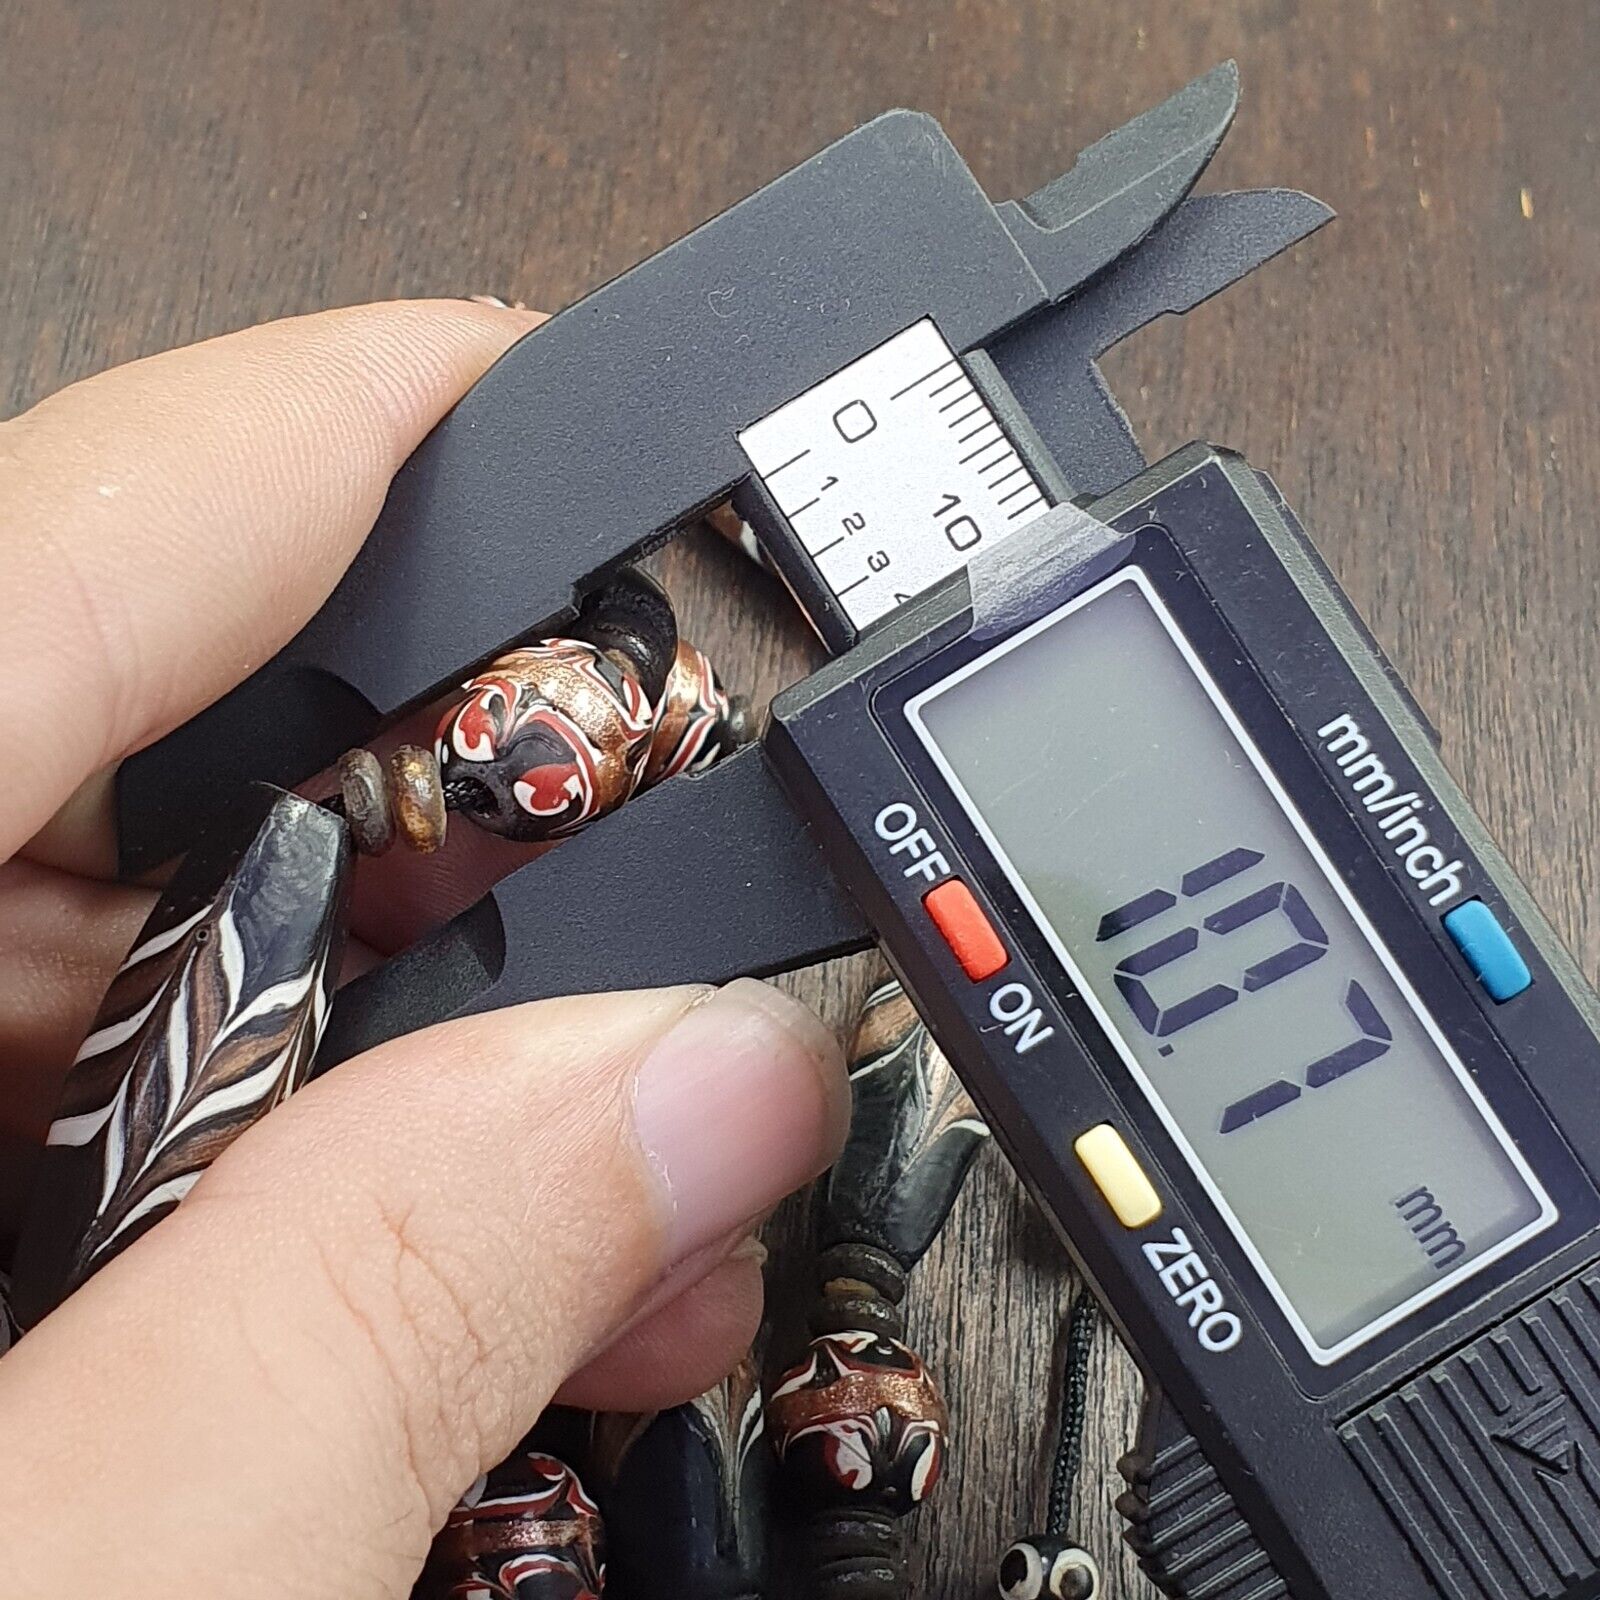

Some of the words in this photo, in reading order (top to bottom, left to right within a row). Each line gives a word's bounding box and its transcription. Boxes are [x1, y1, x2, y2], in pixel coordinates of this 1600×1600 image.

[820, 475, 839, 491] 1
[841, 512, 866, 536] 2
[867, 550, 891, 573] 3
[833, 399, 878, 443] 0
[933, 493, 982, 551] 10
[873, 802, 951, 883] OFF
[1317, 713, 1462, 908] mm/inch
[988, 982, 1055, 1054] ON
[1095, 847, 1393, 1134] 10.7
[1395, 1184, 1467, 1269] mm
[1141, 1226, 1243, 1352] ZERO
